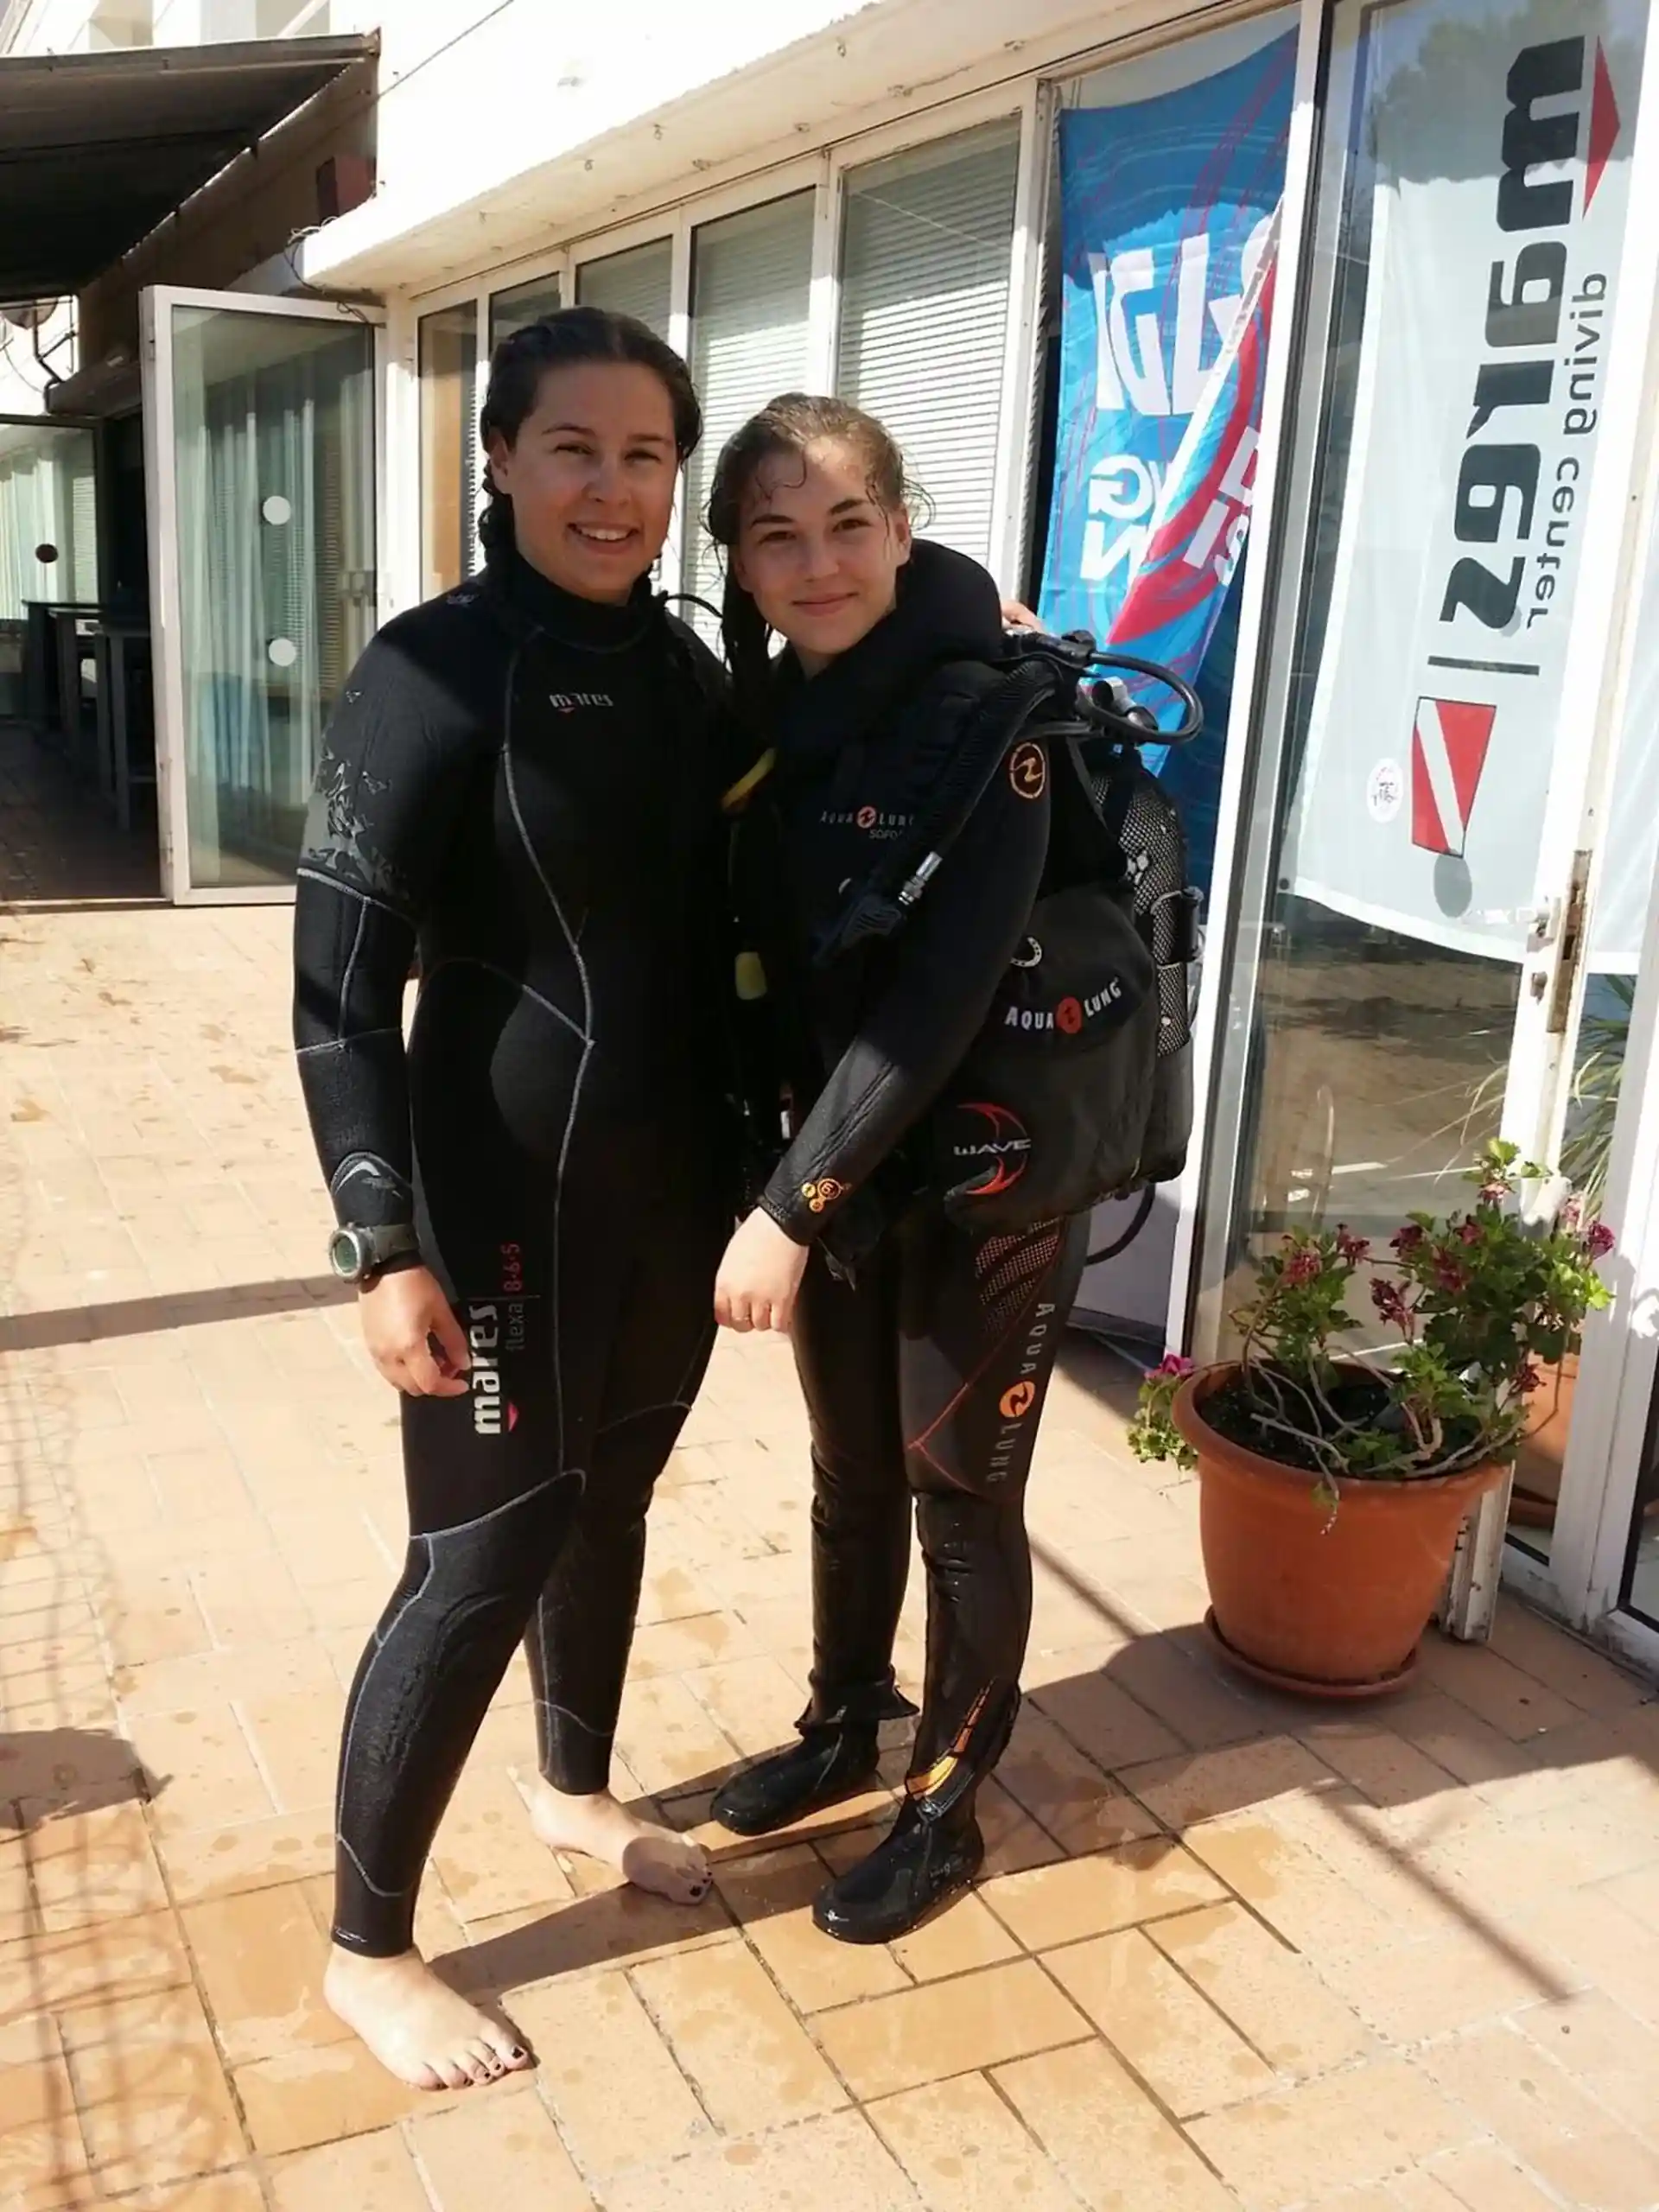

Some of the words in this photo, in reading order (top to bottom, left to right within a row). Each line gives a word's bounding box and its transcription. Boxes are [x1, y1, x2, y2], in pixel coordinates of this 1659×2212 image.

[818, 810, 854, 825] AQUA
[1004, 1006, 1054, 1030] AQUA
[1083, 981, 1122, 1017] LUNG
[953, 1138, 1033, 1156] WAVE
[505, 1303, 524, 1351] flexa
[1020, 1303, 1056, 1375] AQUA
[468, 1304, 501, 1434] mares
[986, 1422, 1024, 1483] LUNG
